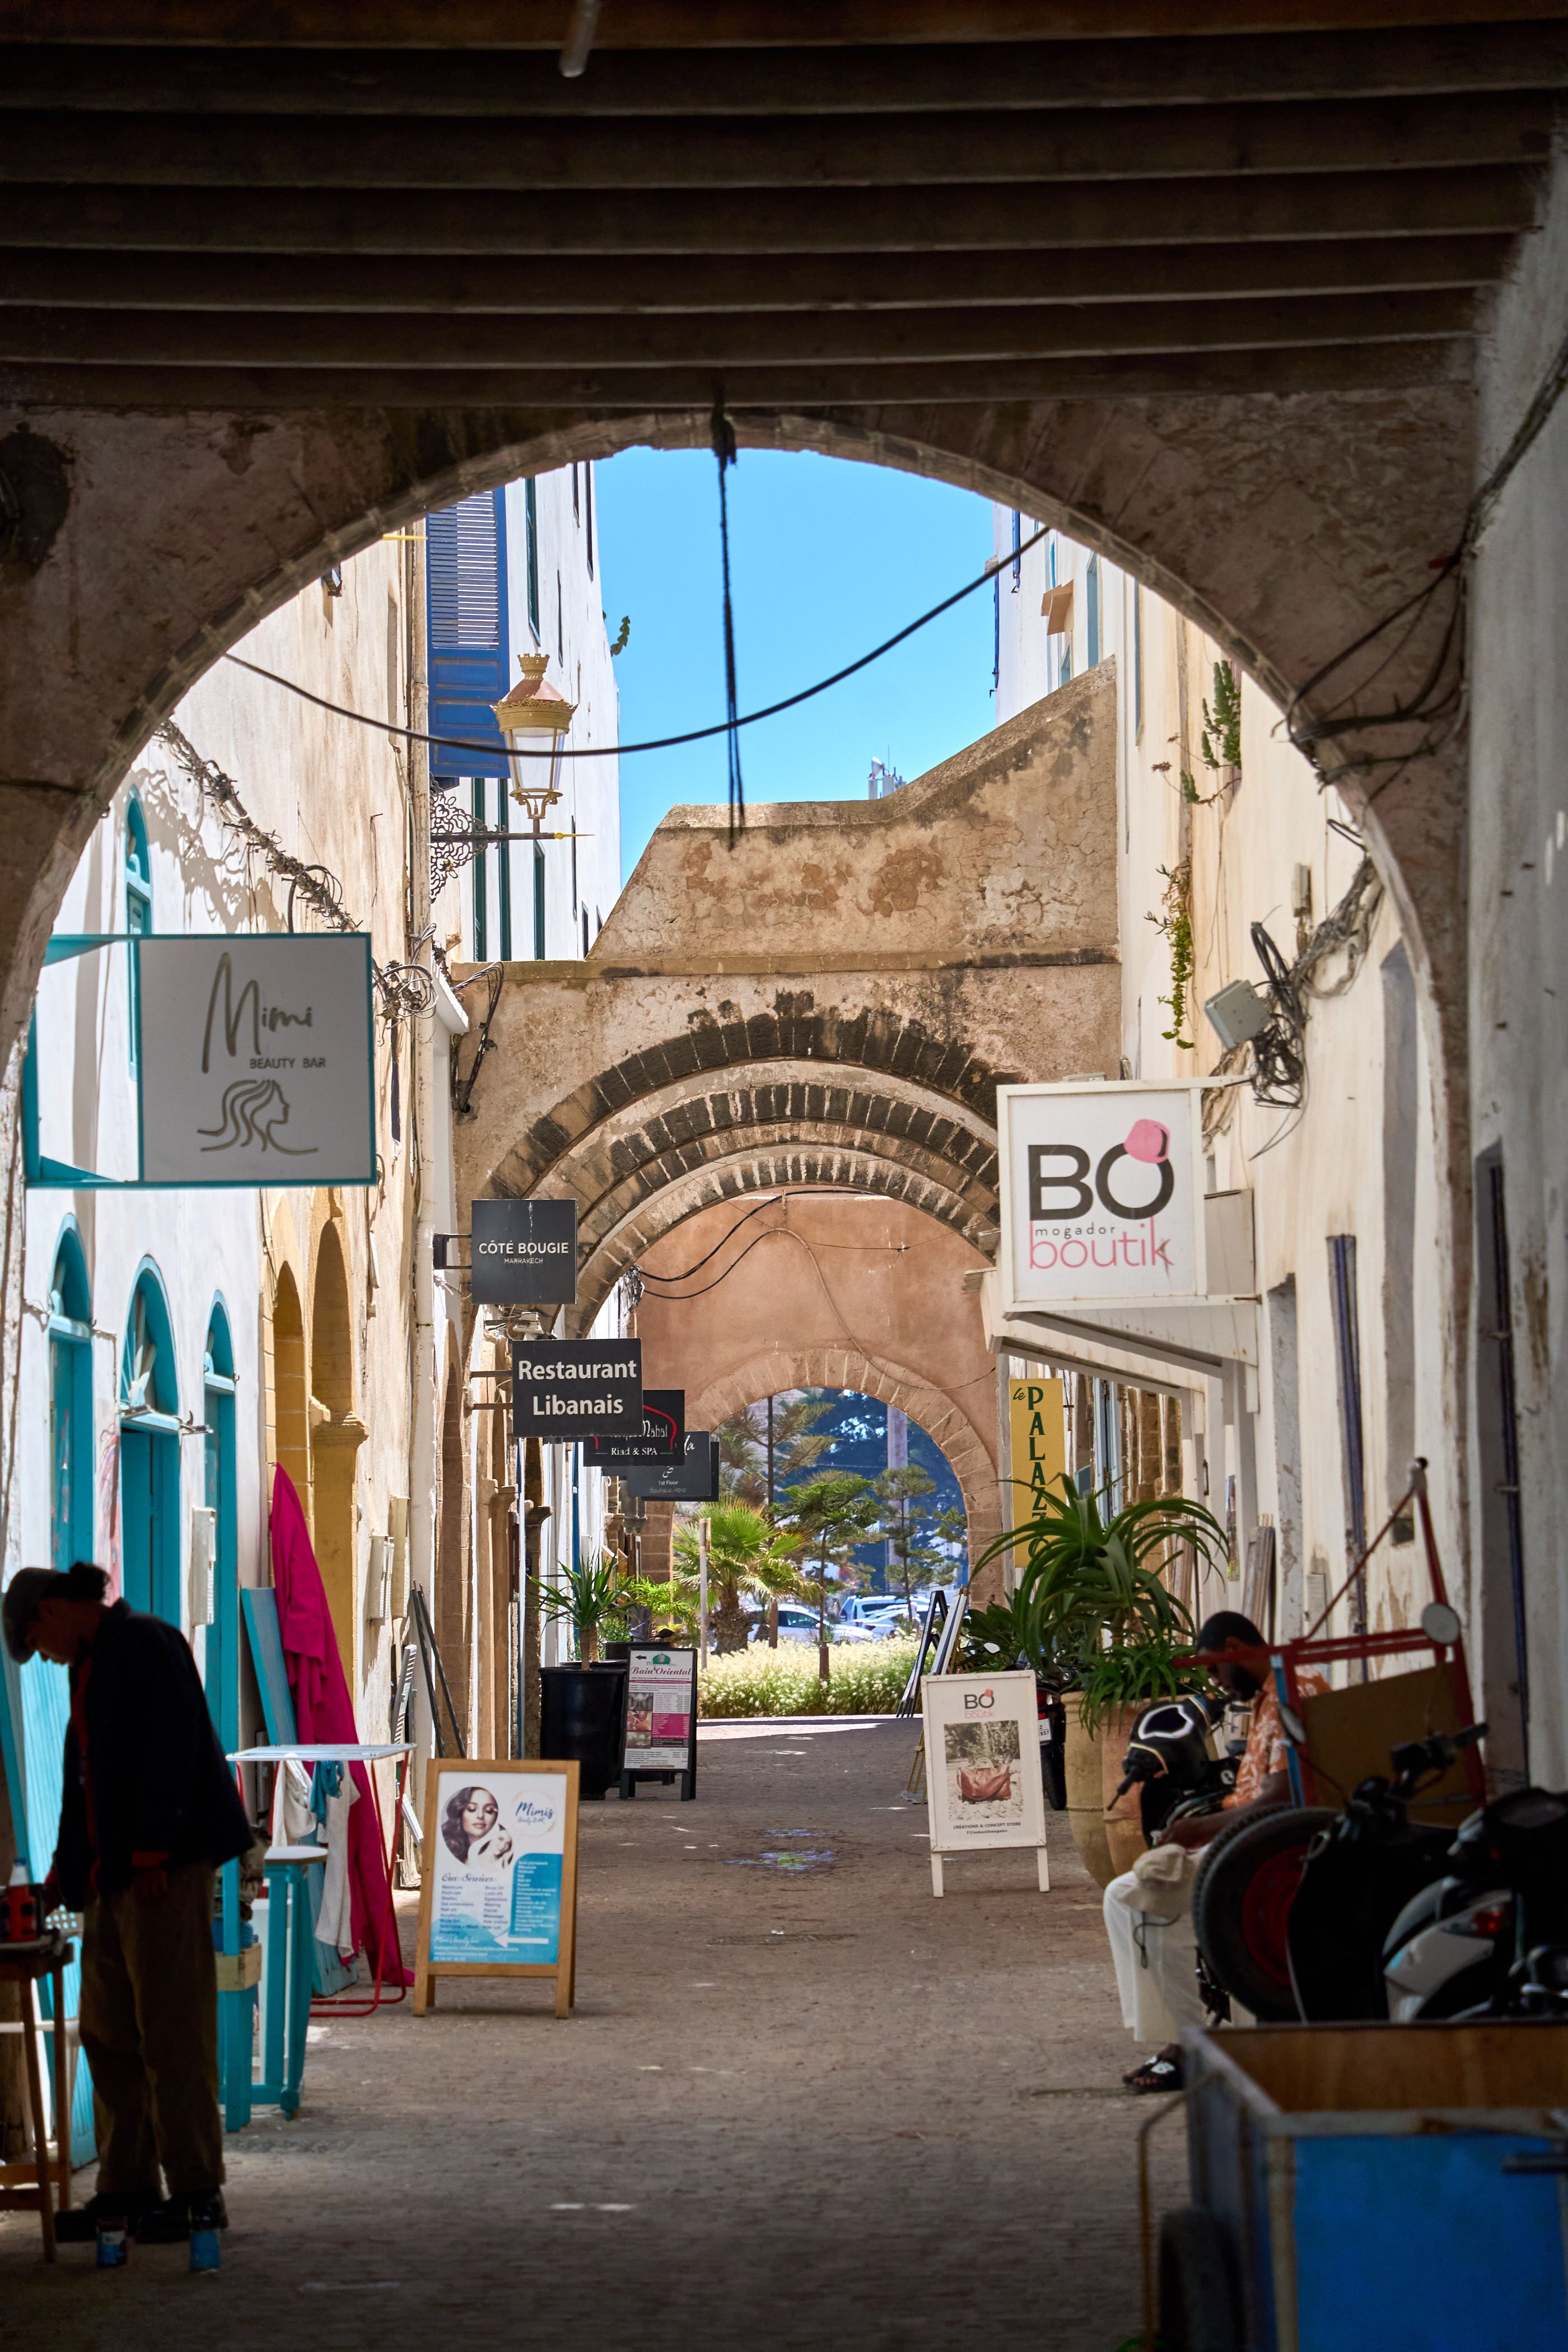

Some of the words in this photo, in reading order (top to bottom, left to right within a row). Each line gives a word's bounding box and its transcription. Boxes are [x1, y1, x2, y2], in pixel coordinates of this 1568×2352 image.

[201, 951, 312, 1074] Mimi
[250, 1058, 295, 1069] BEAUTY
[303, 1057, 326, 1068] BAR
[1028, 1142, 1174, 1221] BO
[1035, 1222, 1116, 1239] mogador
[479, 1240, 514, 1254] CÔTÉ
[519, 1242, 569, 1254] BOUGIE
[1029, 1216, 1174, 1270] boutik
[518, 1359, 637, 1380] Restaurant
[1012, 1387, 1026, 1401] le
[533, 1394, 624, 1416] Libanais
[611, 1448, 630, 1456] Riad
[642, 1448, 657, 1456] SPA
[655, 1667, 692, 1676] Oriental
[964, 1693, 995, 1709] BO
